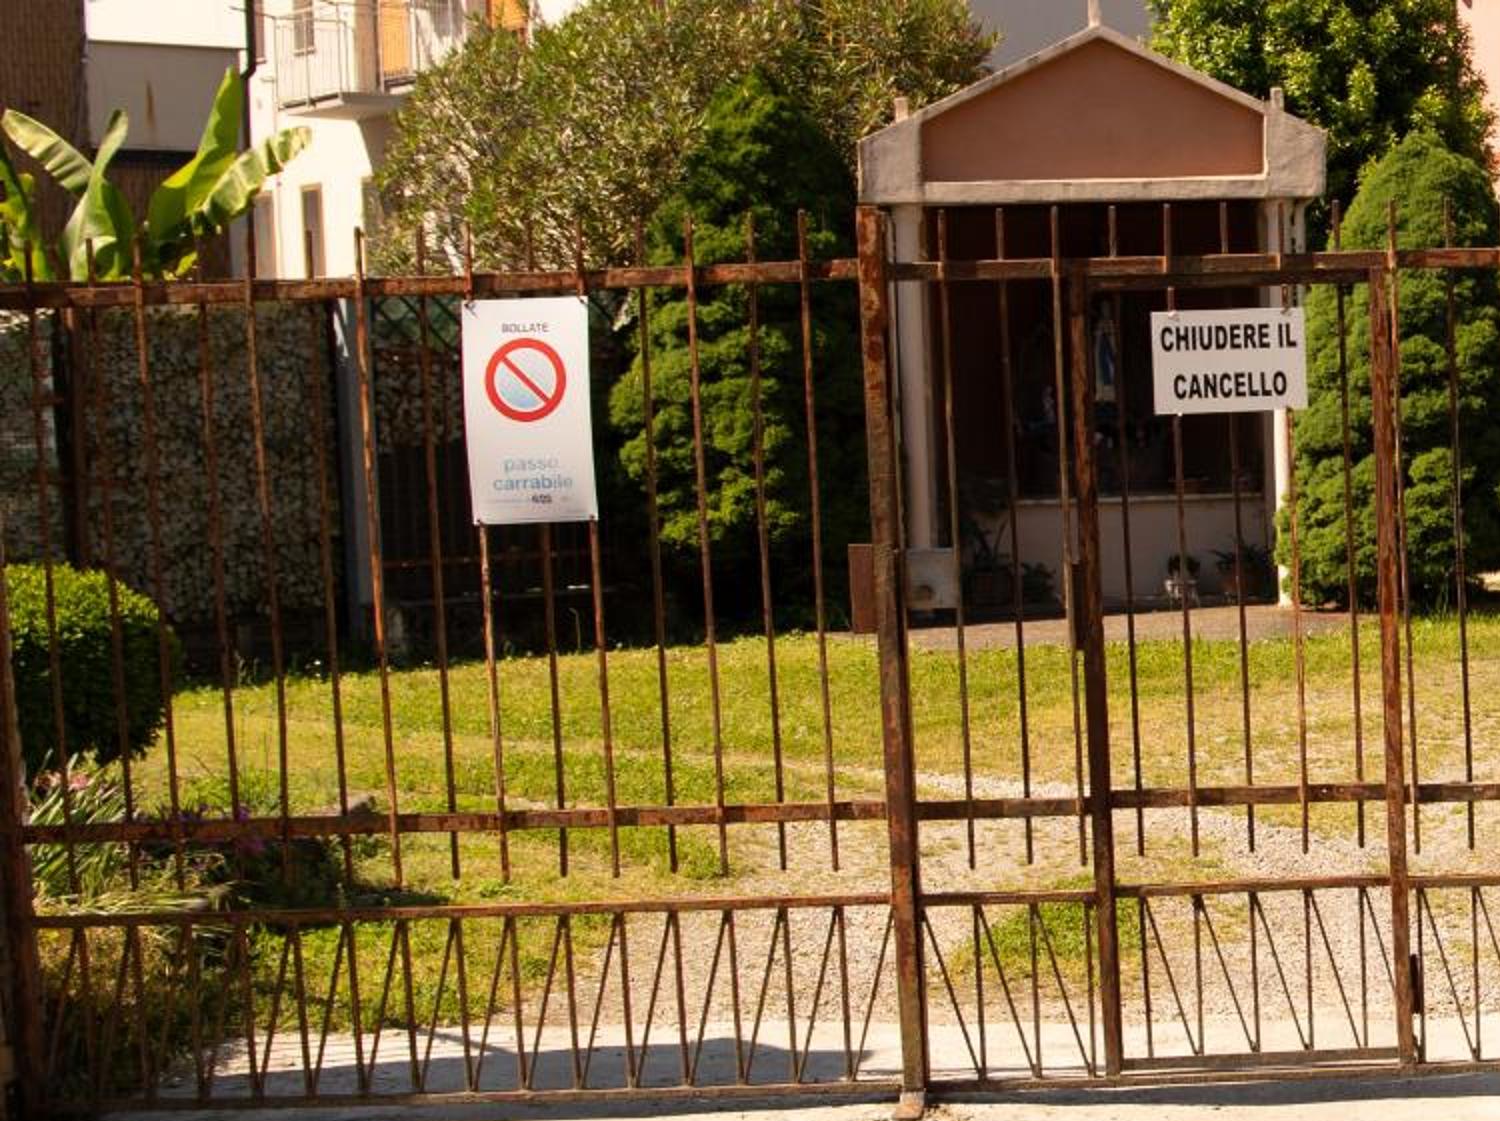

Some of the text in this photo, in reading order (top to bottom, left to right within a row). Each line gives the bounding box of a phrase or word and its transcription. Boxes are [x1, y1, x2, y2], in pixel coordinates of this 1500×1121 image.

[501, 322, 551, 333] BOLLATE
[1160, 323, 1297, 352] CHIUDERE IL
[1173, 371, 1287, 400] CANCELLO
[503, 457, 560, 474] passo
[493, 474, 574, 491] carrabile
